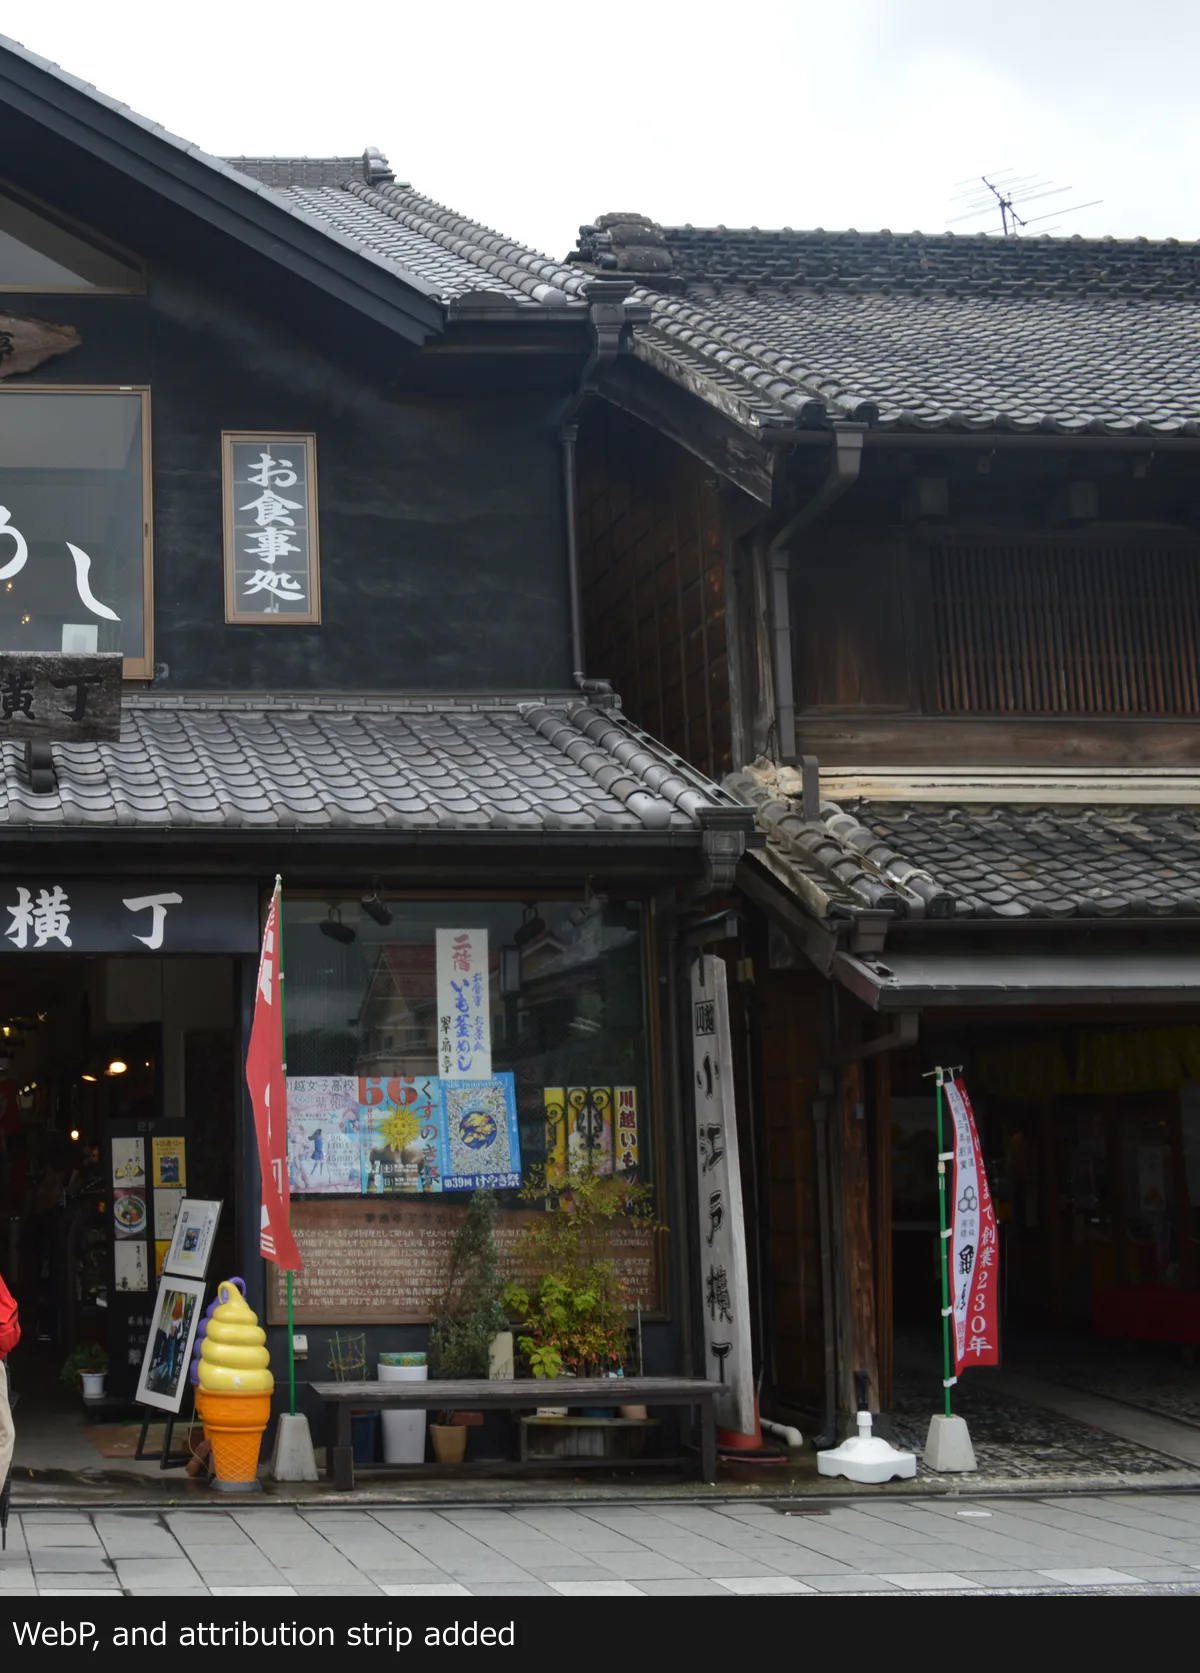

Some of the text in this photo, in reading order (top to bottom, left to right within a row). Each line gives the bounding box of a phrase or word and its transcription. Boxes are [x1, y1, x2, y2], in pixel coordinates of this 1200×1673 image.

[240, 452, 306, 601] お食事処
[450, 978, 473, 1072] いも釜めし
